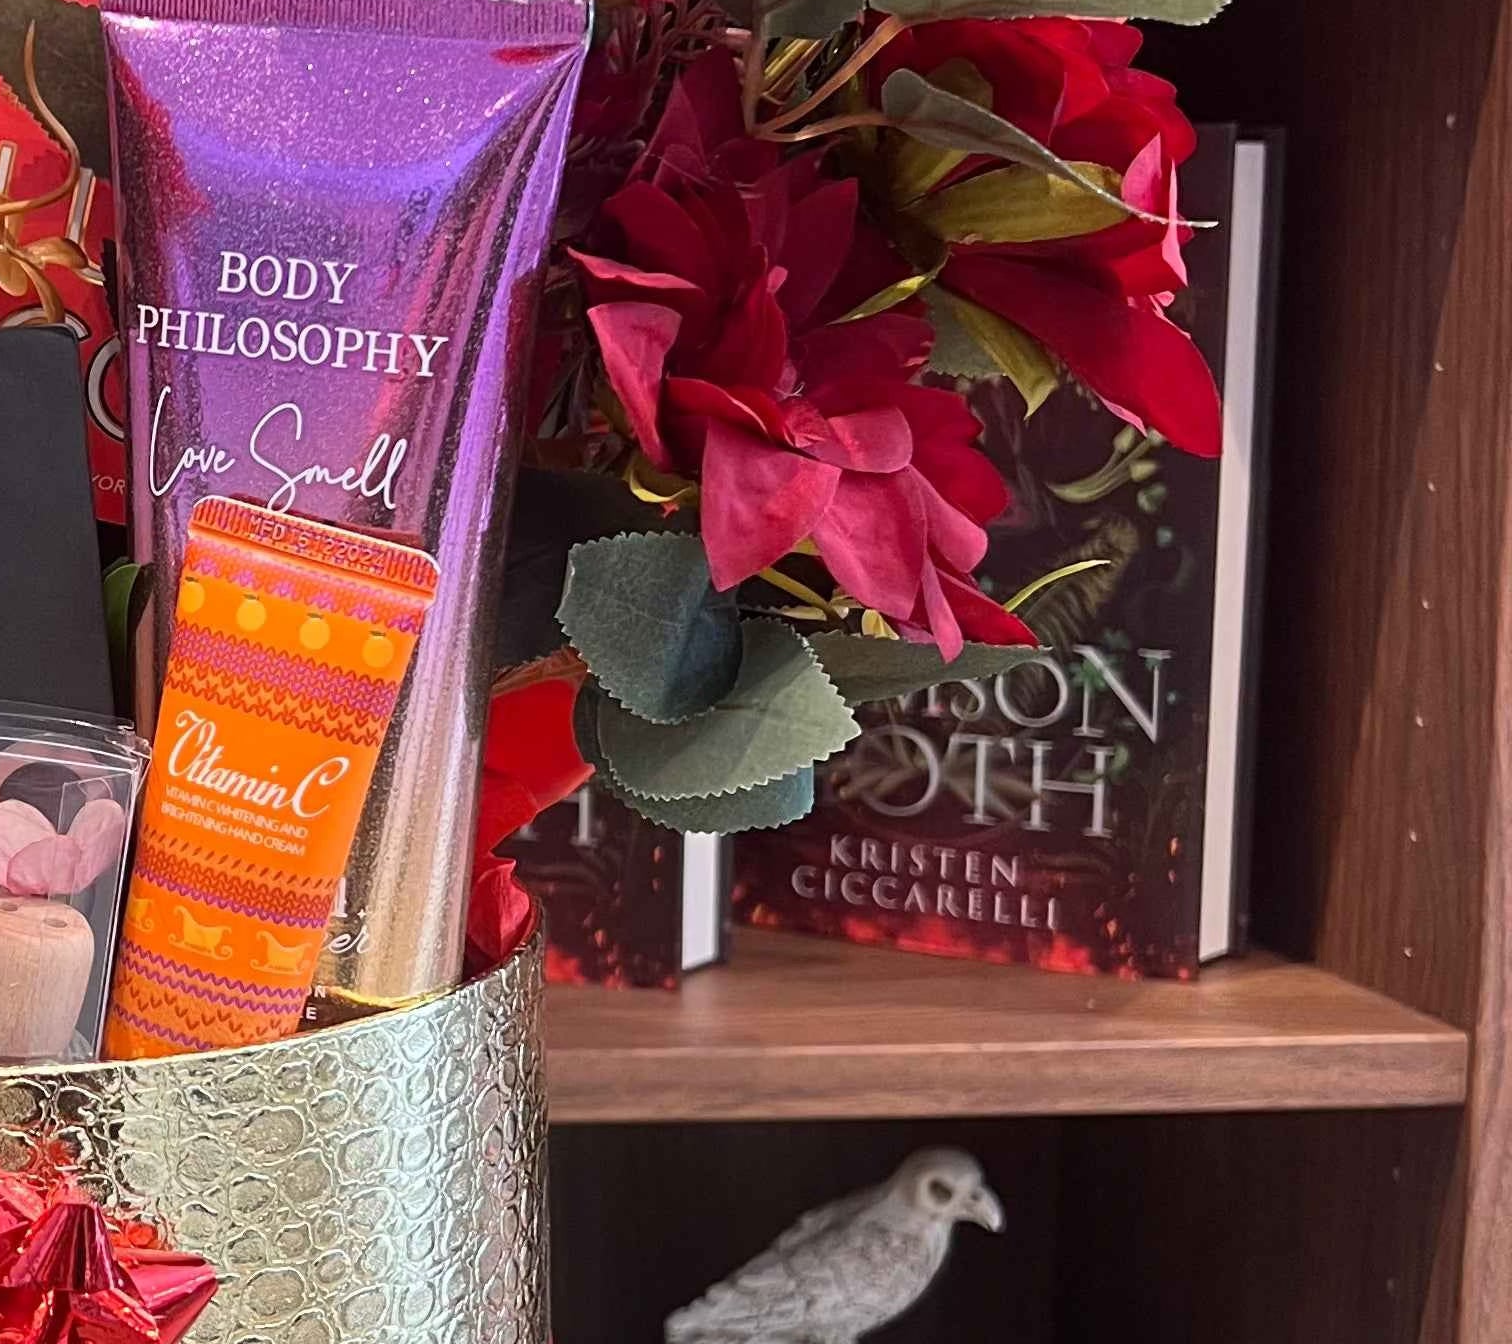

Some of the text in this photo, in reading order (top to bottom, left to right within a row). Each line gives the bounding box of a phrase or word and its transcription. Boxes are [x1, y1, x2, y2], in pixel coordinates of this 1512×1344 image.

[217, 251, 357, 304] BODY
[136, 304, 448, 377] PHILOSOPHY
[150, 386, 235, 496] Love
[250, 403, 408, 514] Smell
[291, 757, 350, 818] C
[855, 725, 1116, 839] OTH
[227, 824, 263, 845] HAND
[264, 835, 305, 857] CREAM
[279, 824, 308, 839] AND
[830, 833, 1020, 888] KRISTEN
[791, 865, 1059, 931] CICCARELLI
